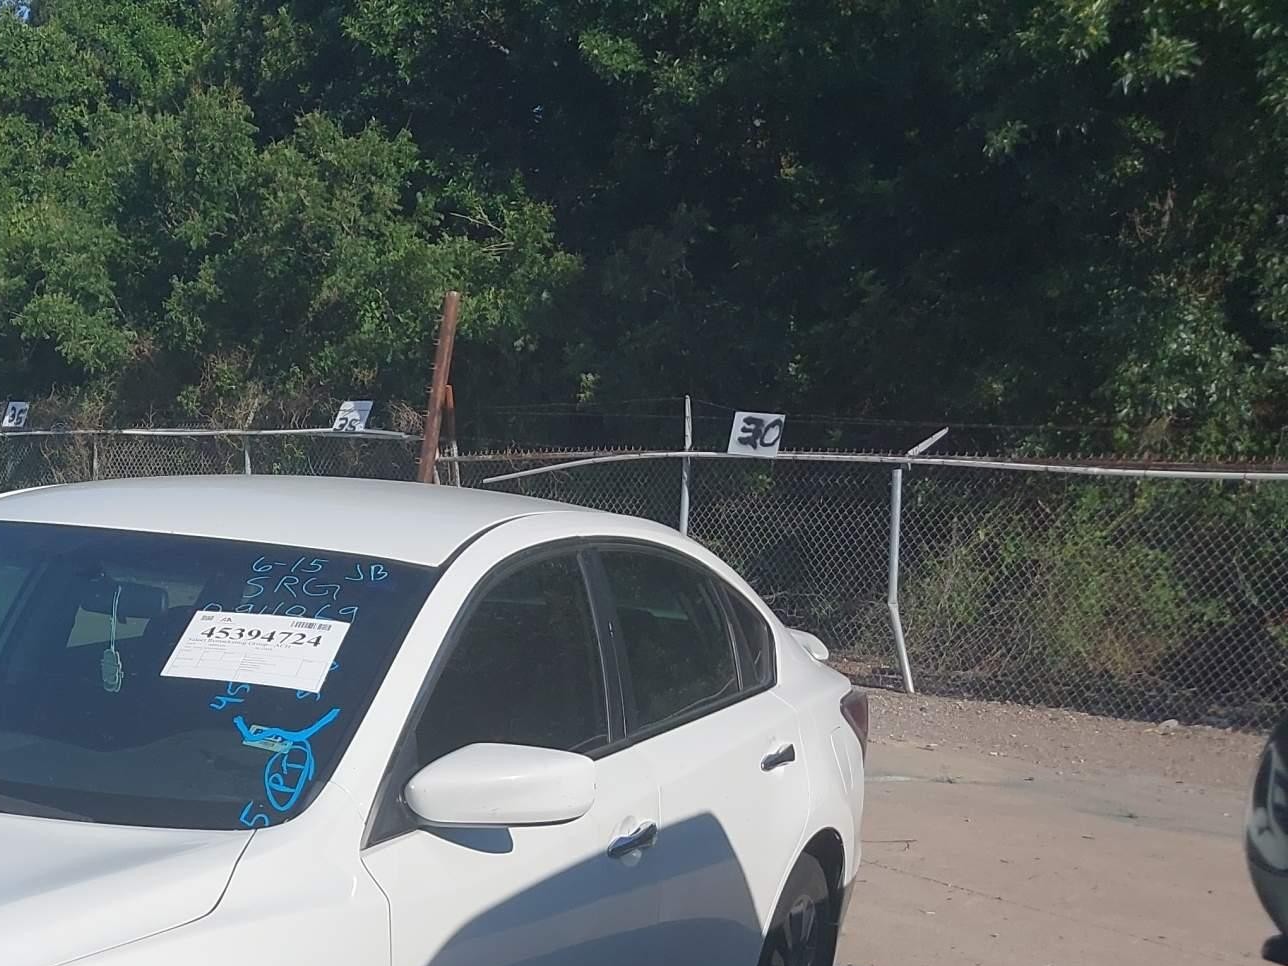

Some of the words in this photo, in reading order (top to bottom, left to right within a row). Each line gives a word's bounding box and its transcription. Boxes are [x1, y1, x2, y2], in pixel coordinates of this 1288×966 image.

[737, 416, 783, 450] 30
[252, 556, 329, 573] 6-15
[200, 626, 323, 648] 45394724
